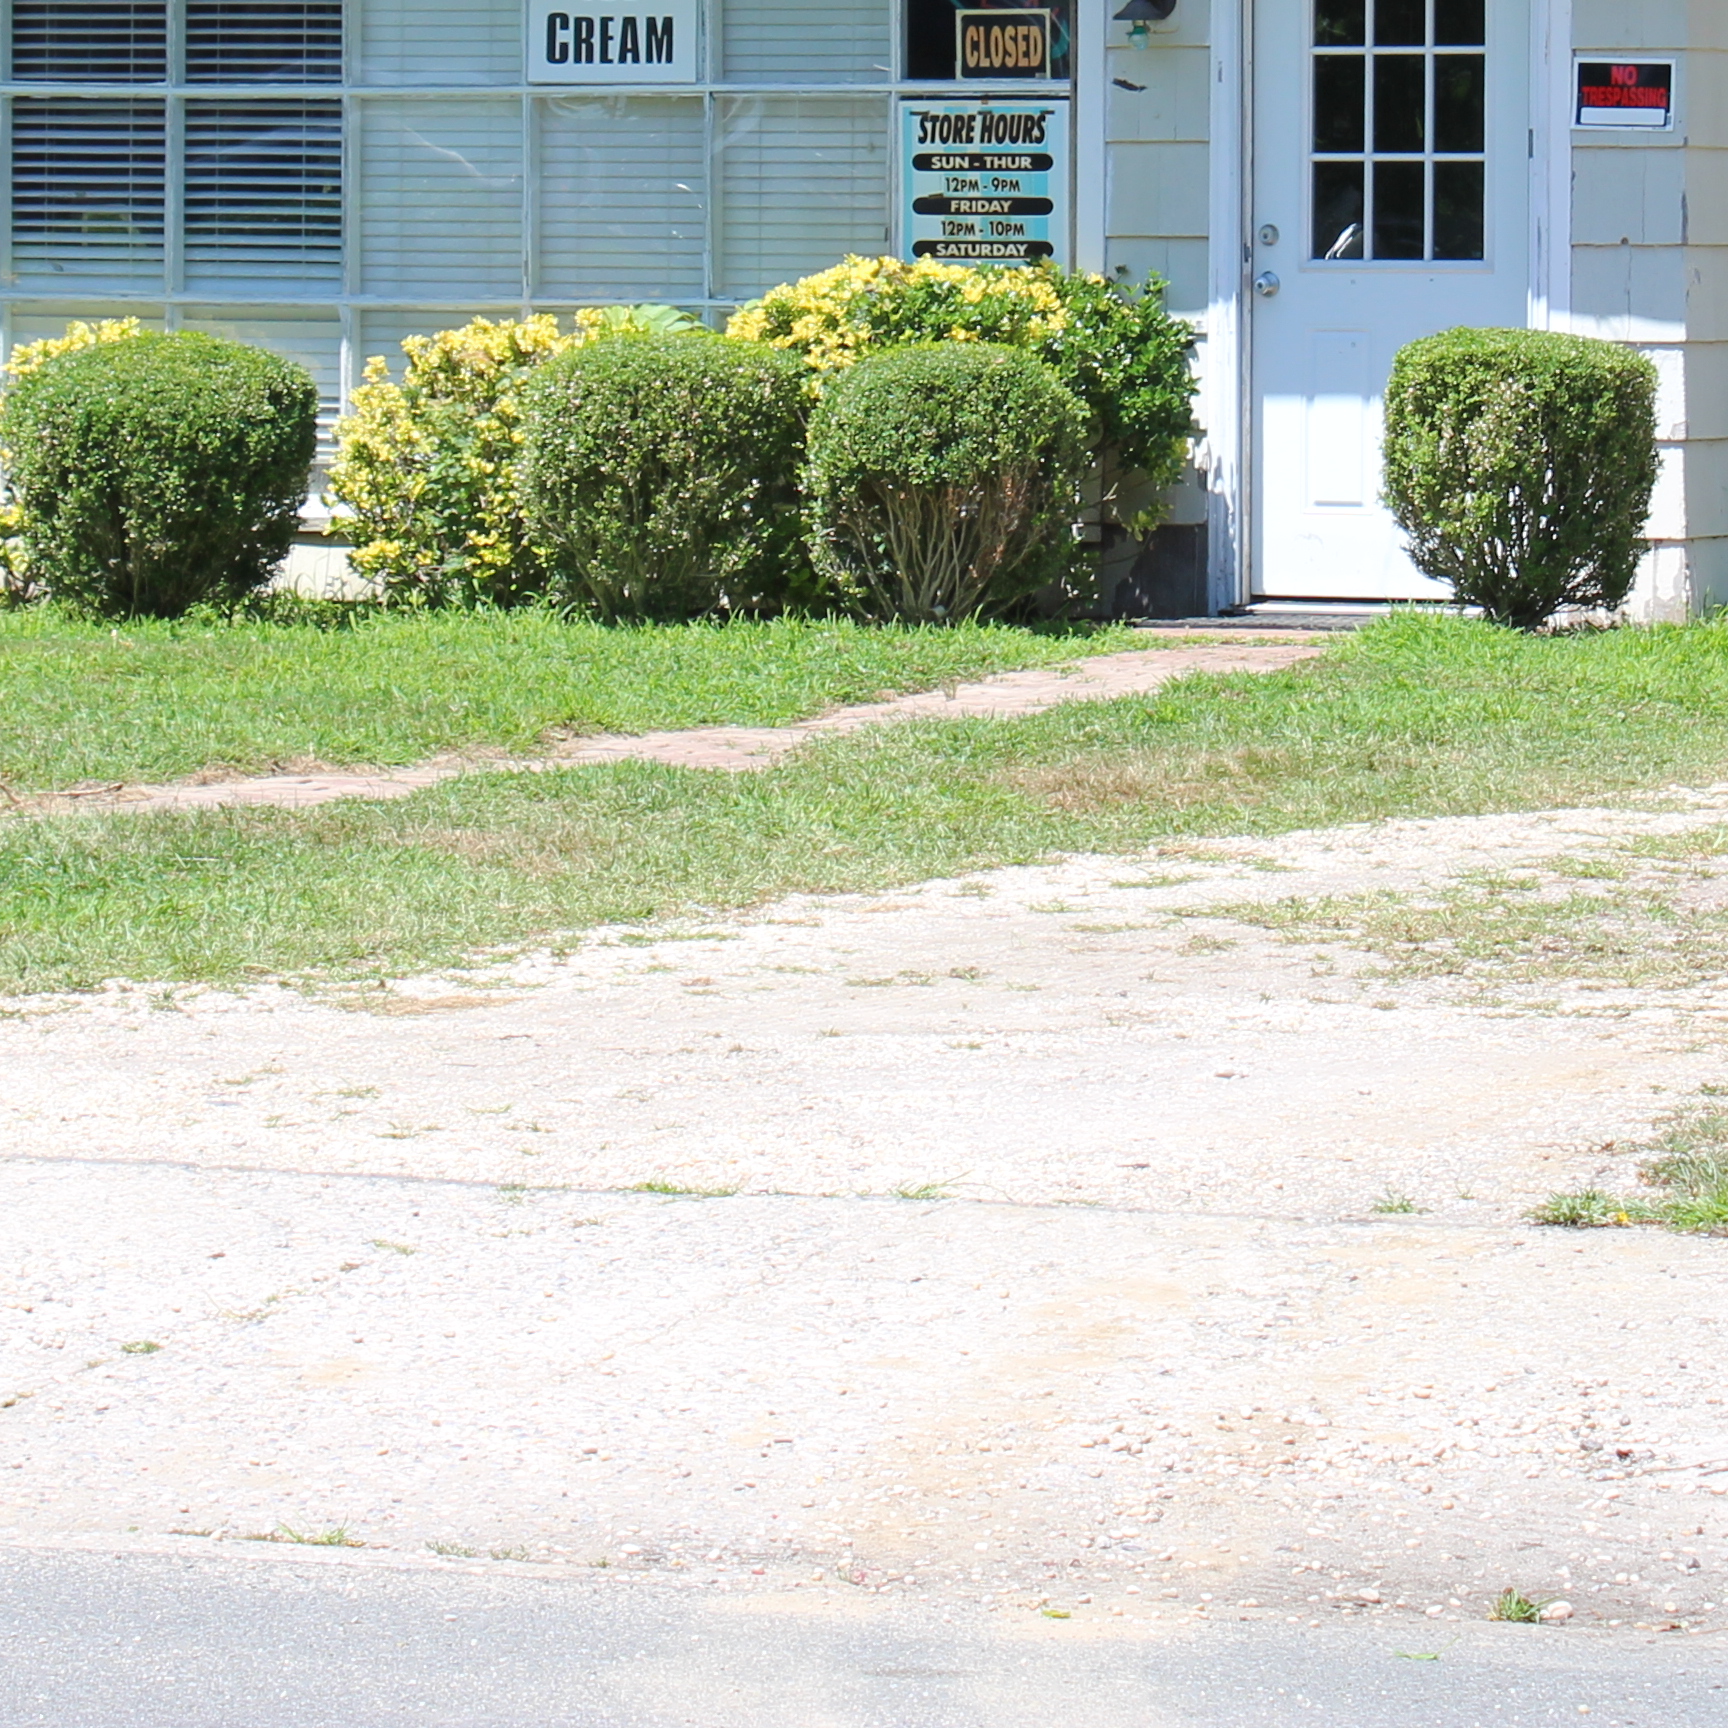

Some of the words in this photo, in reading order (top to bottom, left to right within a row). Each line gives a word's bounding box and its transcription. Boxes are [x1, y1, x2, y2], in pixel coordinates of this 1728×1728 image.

[546, 12, 674, 65] CREAM
[964, 24, 1043, 68] CLOSED
[1610, 65, 1639, 86] NO
[1581, 85, 1668, 108] TRESPASSING
[917, 113, 977, 145] STORE
[979, 113, 1047, 145] HOURS
[931, 155, 970, 170] SUN
[983, 156, 1033, 170] THUR
[945, 177, 980, 193] 12PM
[991, 177, 1021, 193] 9PM
[950, 199, 1013, 214] FRIDAY
[941, 221, 976, 237] 12PM
[989, 221, 1025, 237] 10PM
[936, 243, 1029, 257] SATURDAY
